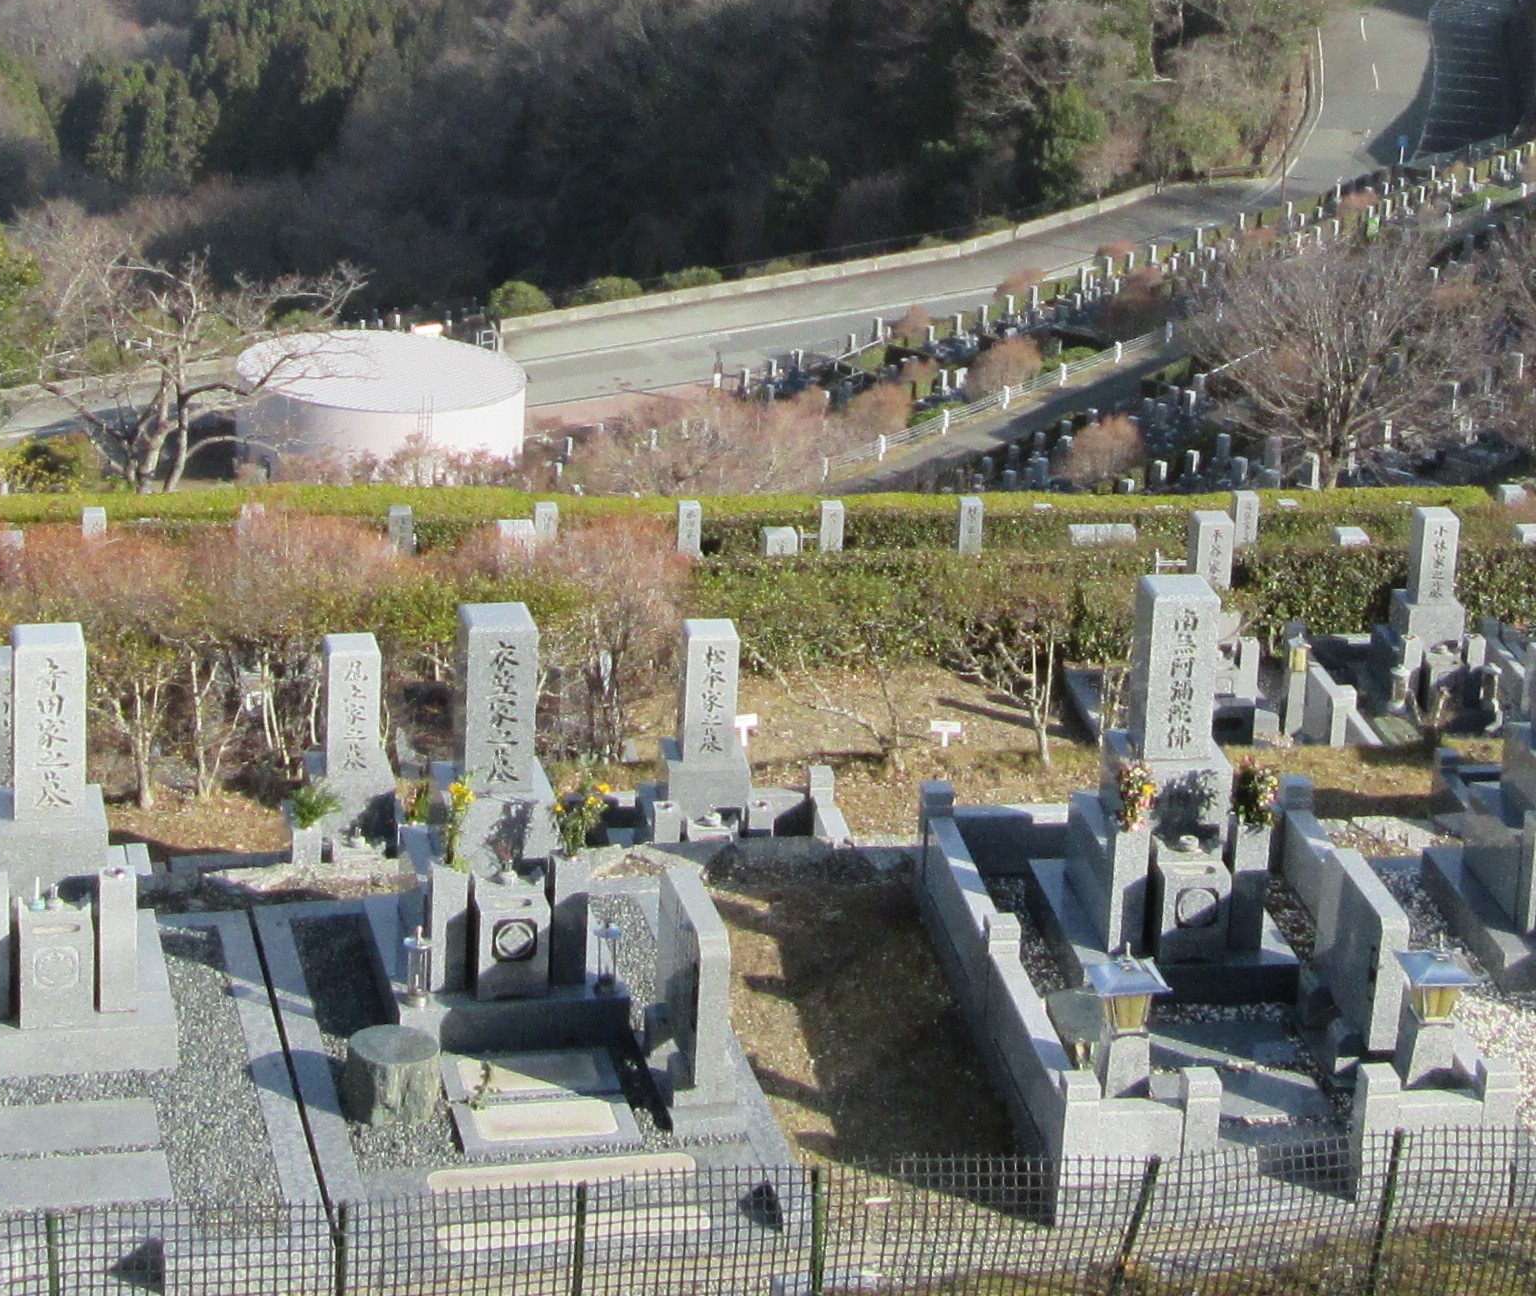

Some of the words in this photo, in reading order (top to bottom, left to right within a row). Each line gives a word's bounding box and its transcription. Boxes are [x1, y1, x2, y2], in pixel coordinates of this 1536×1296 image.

[1428, 525, 1449, 599] 小林家之墓
[34, 657, 74, 808] 寺田家之墓
[486, 640, 521, 783] 衣笠家之墓
[699, 645, 727, 754] 松本家之墓
